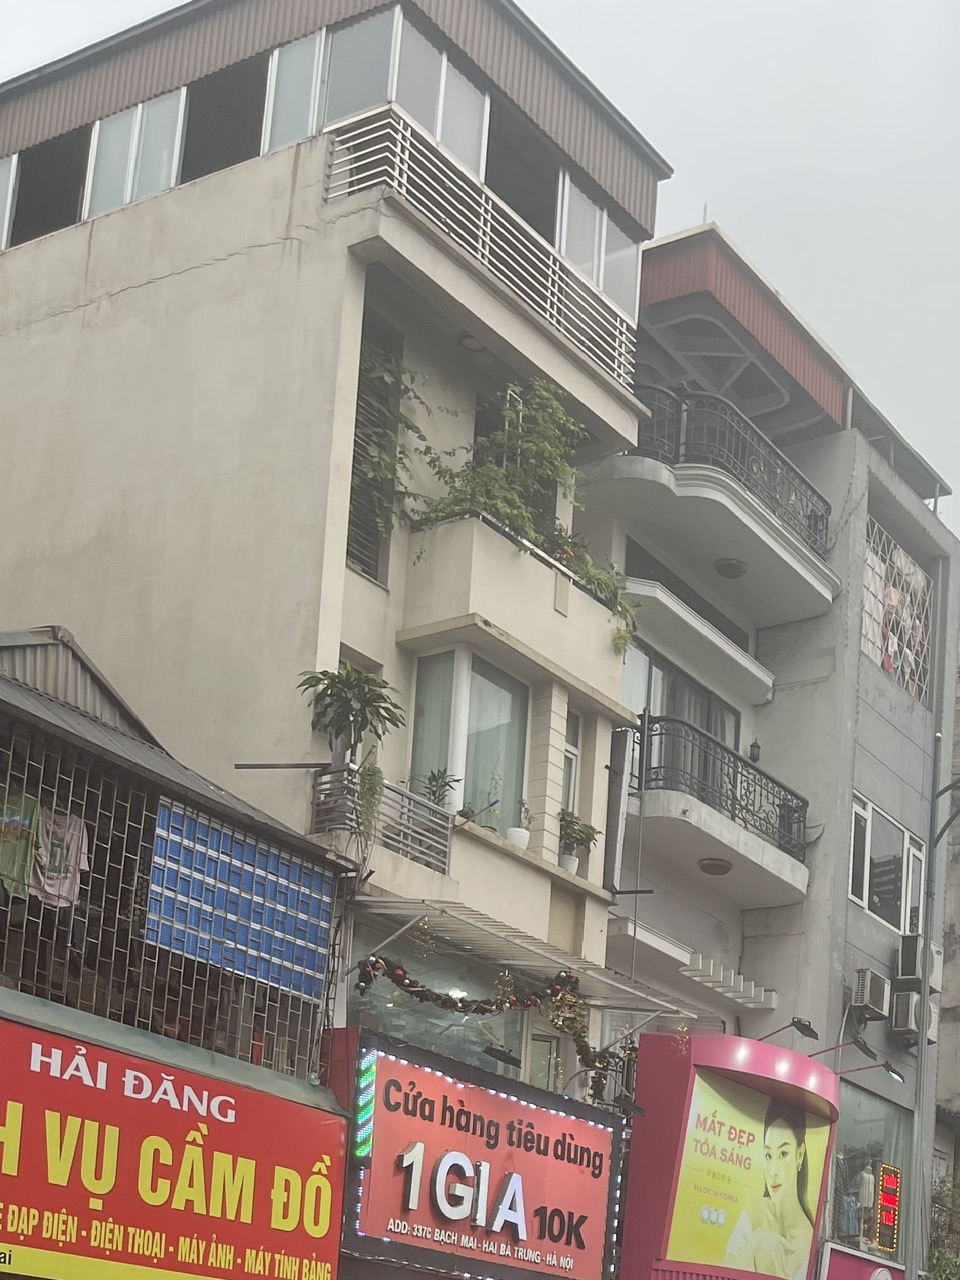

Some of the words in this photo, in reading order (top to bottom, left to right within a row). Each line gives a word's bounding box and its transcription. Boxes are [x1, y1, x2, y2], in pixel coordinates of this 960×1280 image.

[30, 1042, 108, 1090] HẢI
[122, 1069, 236, 1123] ĐĂNG
[383, 1079, 435, 1122] Cửa
[441, 1095, 500, 1149] hàng
[505, 1119, 550, 1157] tiêu
[553, 1132, 604, 1179] dùng
[693, 1138, 717, 1159] TỎA
[720, 1148, 752, 1170] SÁNG
[695, 1110, 725, 1137] MẮT
[727, 1125, 755, 1149] ĐẸP
[45, 1109, 119, 1211] VỤ
[138, 1122, 257, 1224] CẦM
[270, 1154, 332, 1238] ĐỒ
[7, 1204, 39, 1241] ĐẠP
[42, 1208, 78, 1247] ĐIỆN
[90, 1217, 124, 1255] ĐIỆN
[128, 1227, 166, 1263] THOẠI
[177, 1234, 207, 1265] MÁY
[207, 1234, 235, 1270] ẢNH
[244, 1246, 272, 1276] MÁY
[274, 1250, 300, 1280] TÍNH
[387, 1218, 411, 1234] ADD:
[434, 1228, 458, 1245] BẠCH
[460, 1234, 477, 1250] MAI
[482, 1239, 497, 1254] HAI
[499, 1241, 511, 1257] BÀ
[514, 1246, 541, 1263] TRƯNG
[546, 1251, 557, 1266] HÀ
[559, 1254, 574, 1272] NỘI
[534, 1206, 588, 1249] 10K
